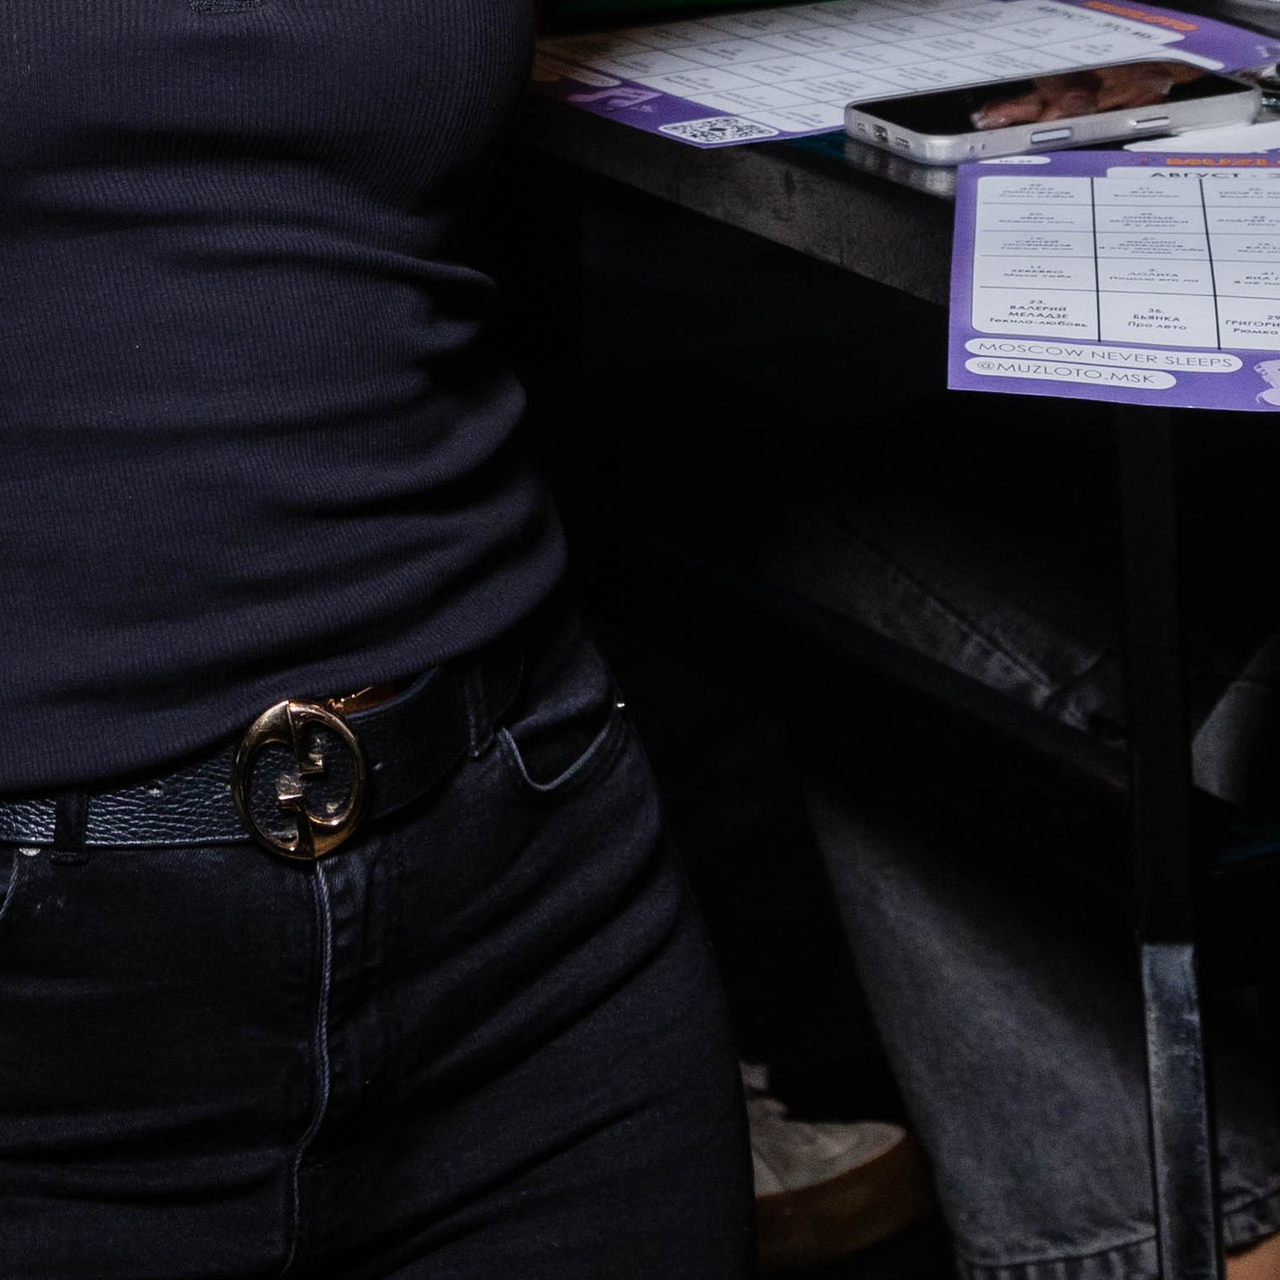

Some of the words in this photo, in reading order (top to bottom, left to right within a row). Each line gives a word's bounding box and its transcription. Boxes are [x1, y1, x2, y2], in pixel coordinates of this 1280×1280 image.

[1007, 311, 1068, 319] МЕЛАДЗЕ
[1133, 313, 1180, 322] БЬЯНКА
[979, 343, 1083, 357] MOSCOW
[1091, 351, 1158, 364] NEVER
[1165, 356, 1232, 368] SLEEPS
[977, 361, 1154, 384] @MUZLOTO.MSK
